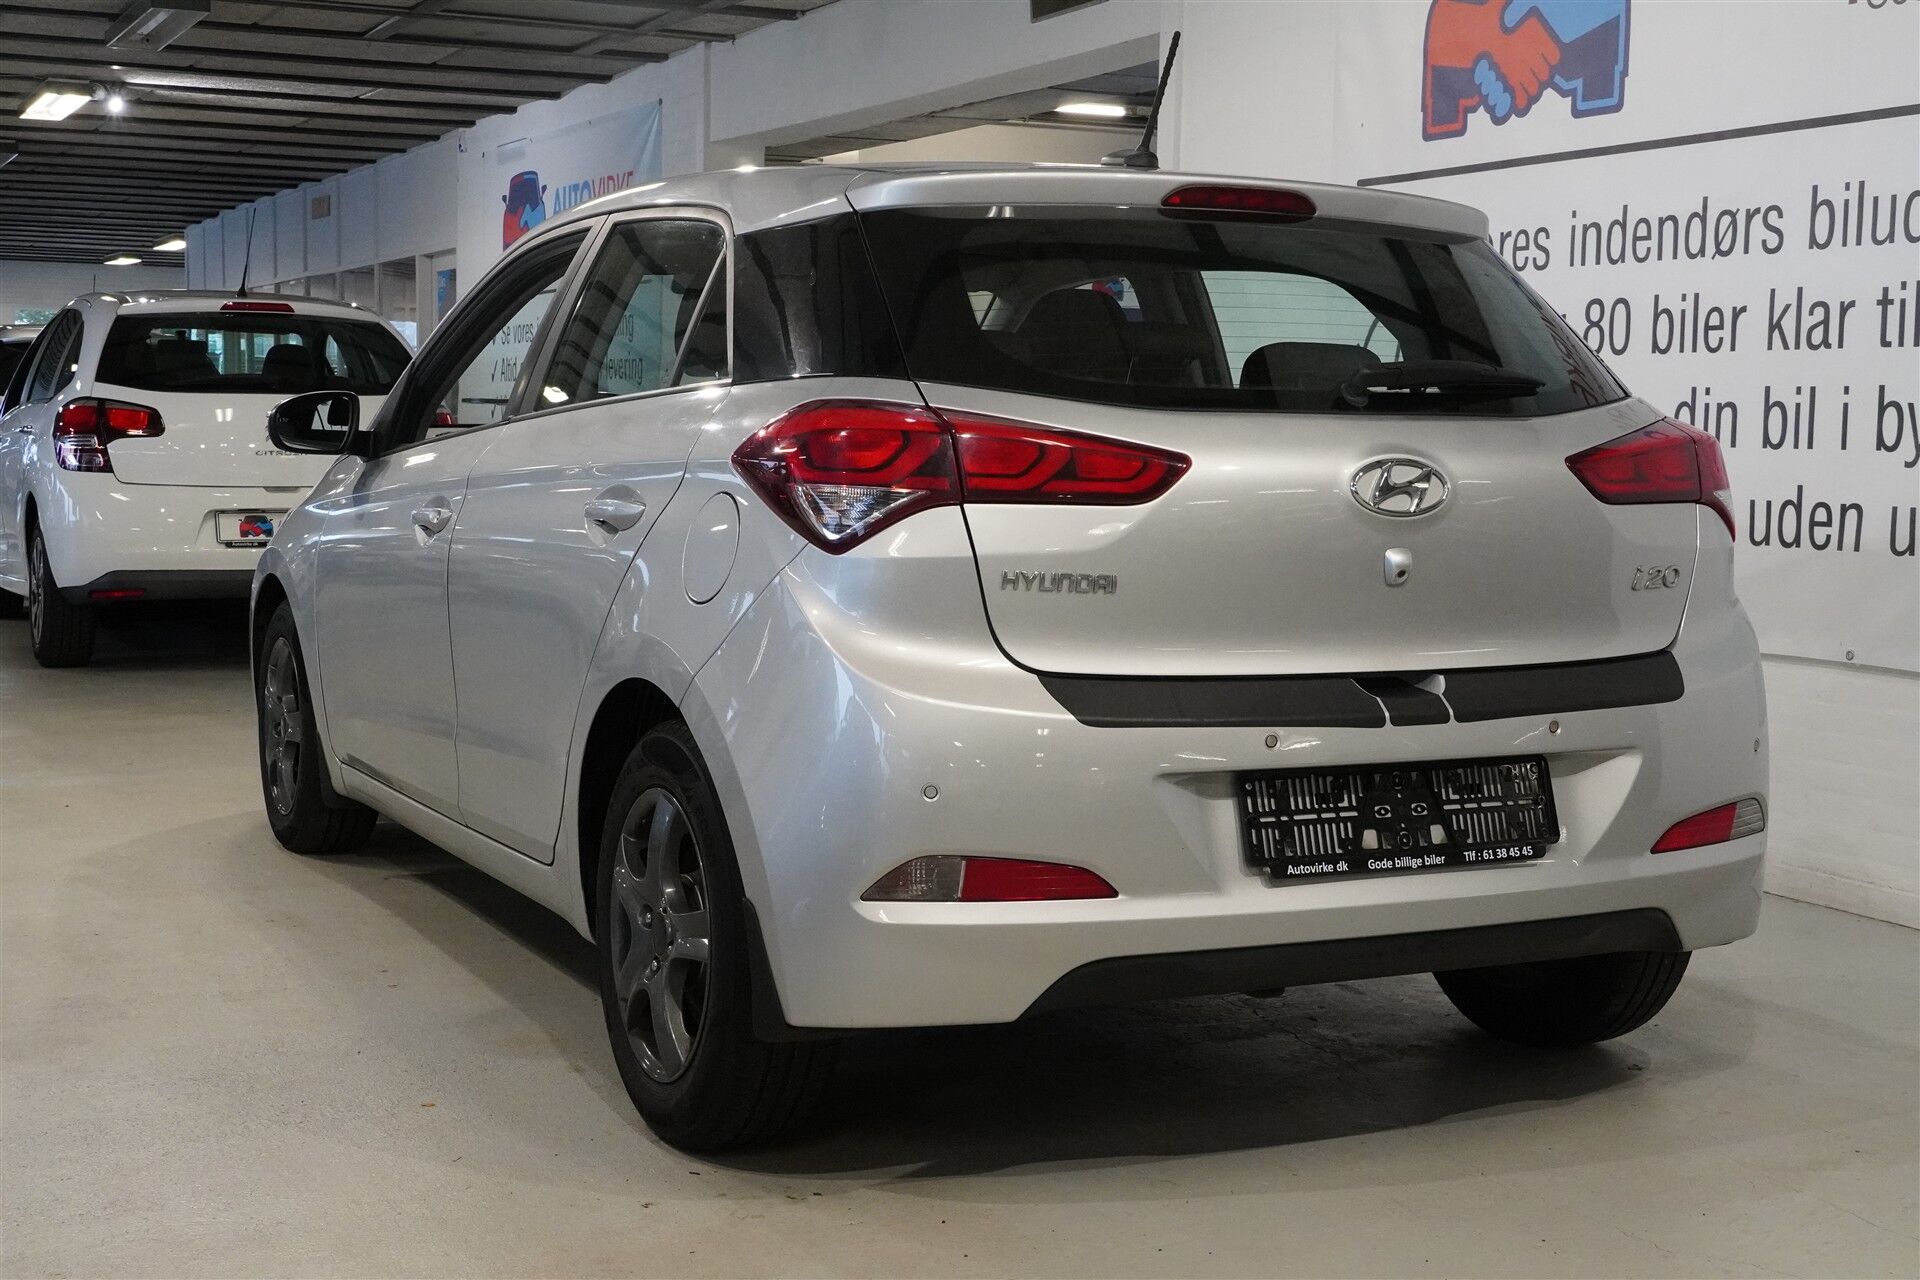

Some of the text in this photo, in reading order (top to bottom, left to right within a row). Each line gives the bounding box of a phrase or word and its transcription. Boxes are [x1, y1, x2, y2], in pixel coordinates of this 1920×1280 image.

[1488, 226, 1551, 272] res
[1569, 195, 1785, 268] indendørs
[1582, 280, 1920, 356] 80 biler klar til
[1762, 385, 1817, 450] bil
[1840, 385, 1850, 450] i
[1749, 484, 1864, 553] uden
[1001, 569, 1118, 595] HYUNDAI
[1631, 565, 1680, 592] i20
[1286, 861, 1334, 876] Autovirke
[1336, 860, 1349, 872] dk
[1367, 857, 1393, 870] Gode
[1394, 856, 1423, 869] billige
[1424, 854, 1446, 866] biler
[1463, 850, 1477, 862] Tlf
[1482, 849, 1495, 860] 61
[1495, 848, 1508, 859] 38
[1509, 846, 1520, 857] 45
[1521, 845, 1534, 856] 45
